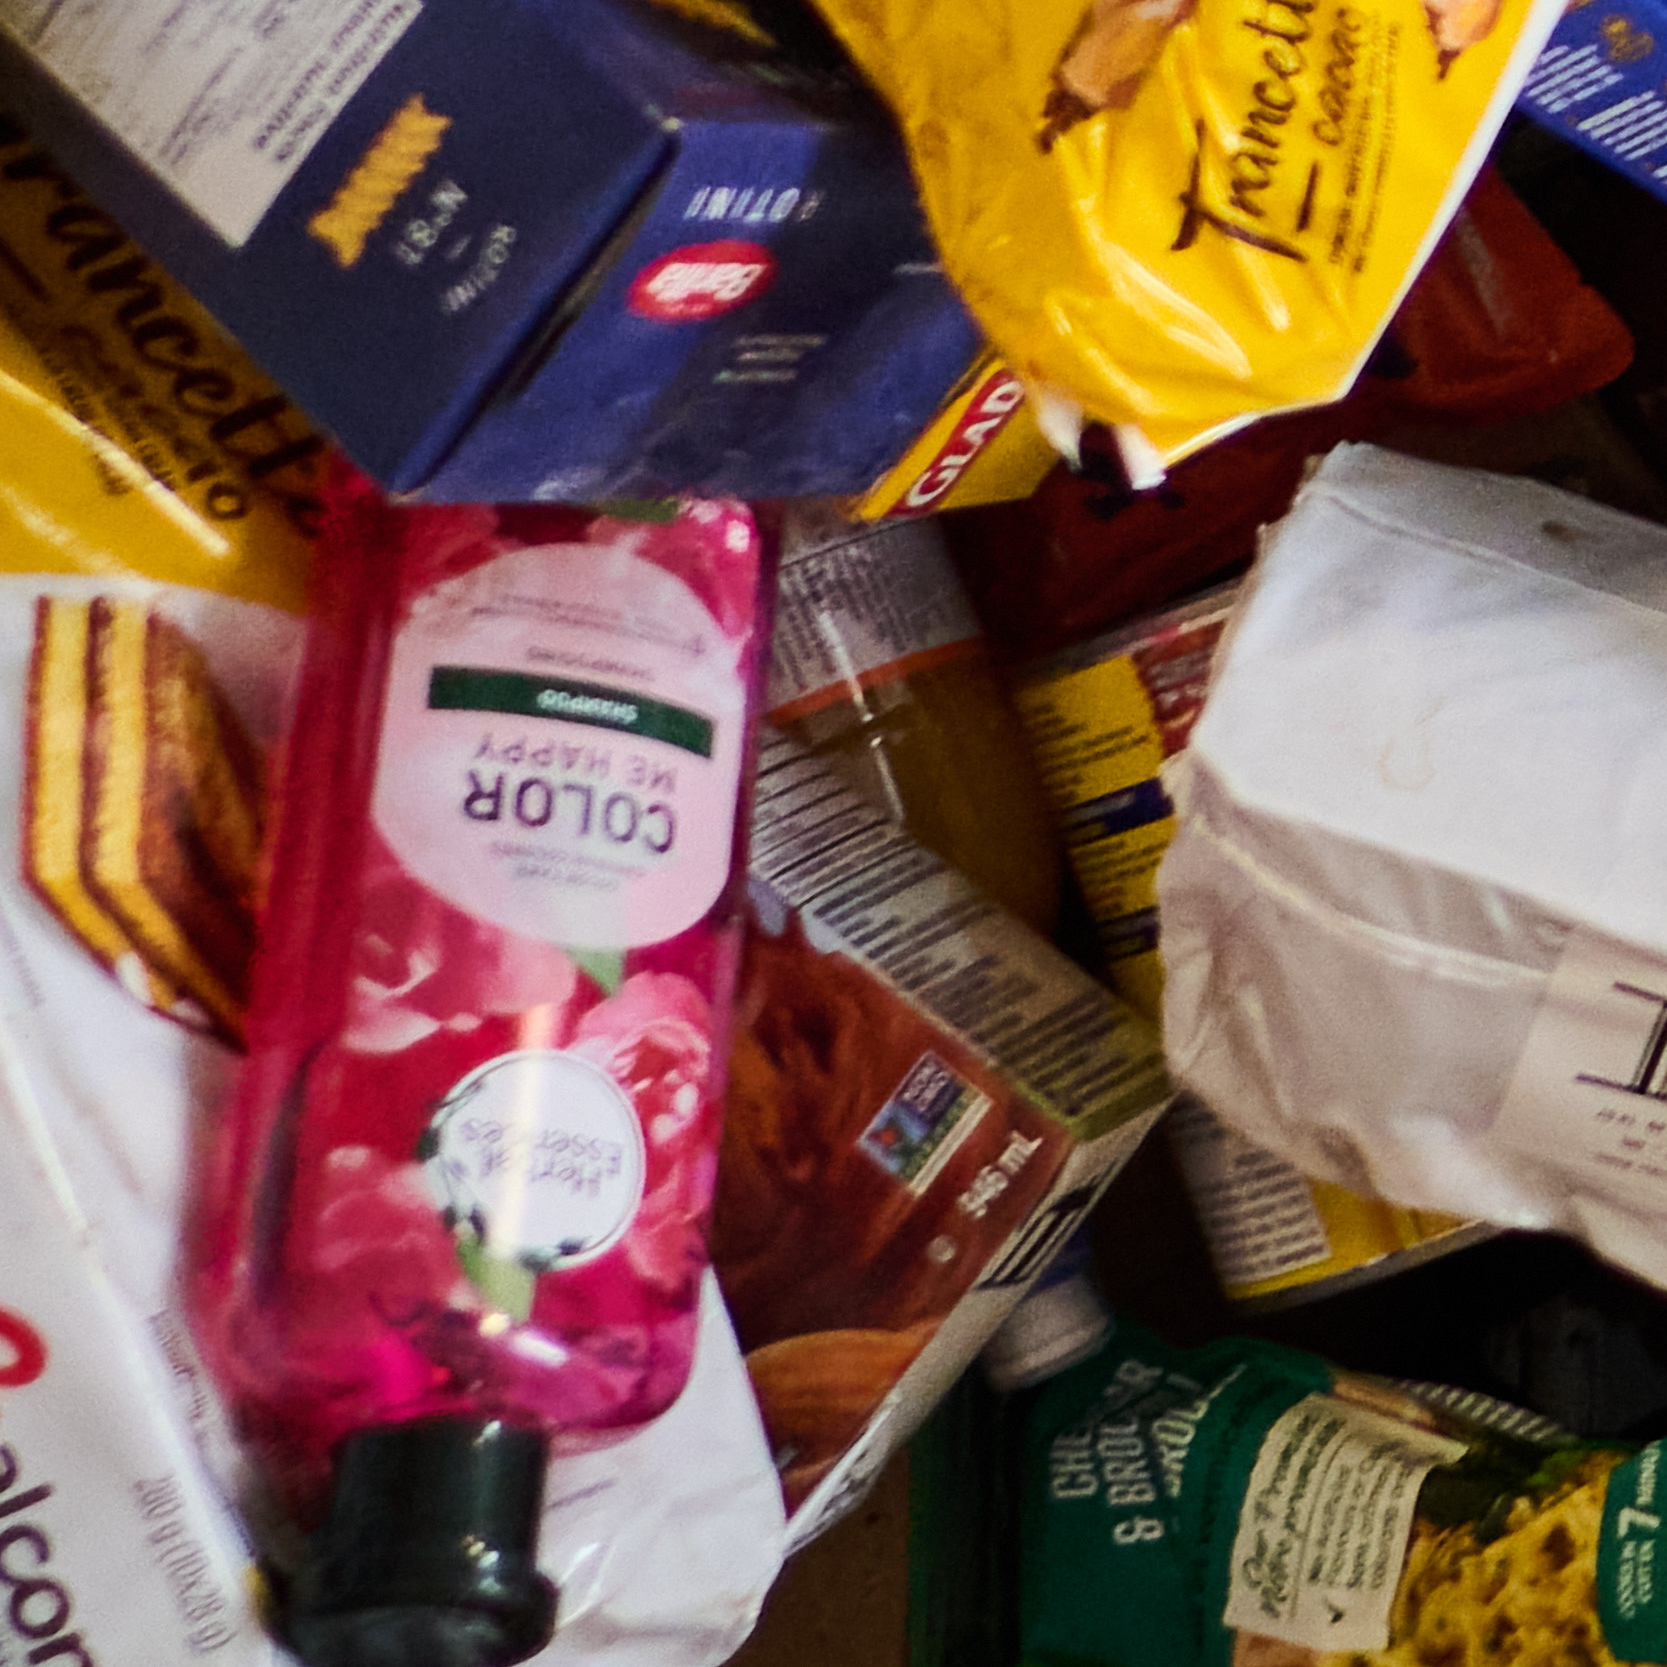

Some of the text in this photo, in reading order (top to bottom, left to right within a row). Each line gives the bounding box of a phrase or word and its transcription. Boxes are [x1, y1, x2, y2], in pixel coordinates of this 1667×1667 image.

[1308, 7, 1365, 144] cacao
[683, 187, 822, 219] ROTINI
[648, 263, 765, 299] Barilla
[907, 382, 1026, 507] GLAD
[535, 688, 638, 724] SHAMPOO
[473, 731, 677, 794] ME HAPPY
[460, 768, 678, 854] COLOR
[1113, 1518, 1163, 1547] &
[1616, 1505, 1659, 1537] 7
